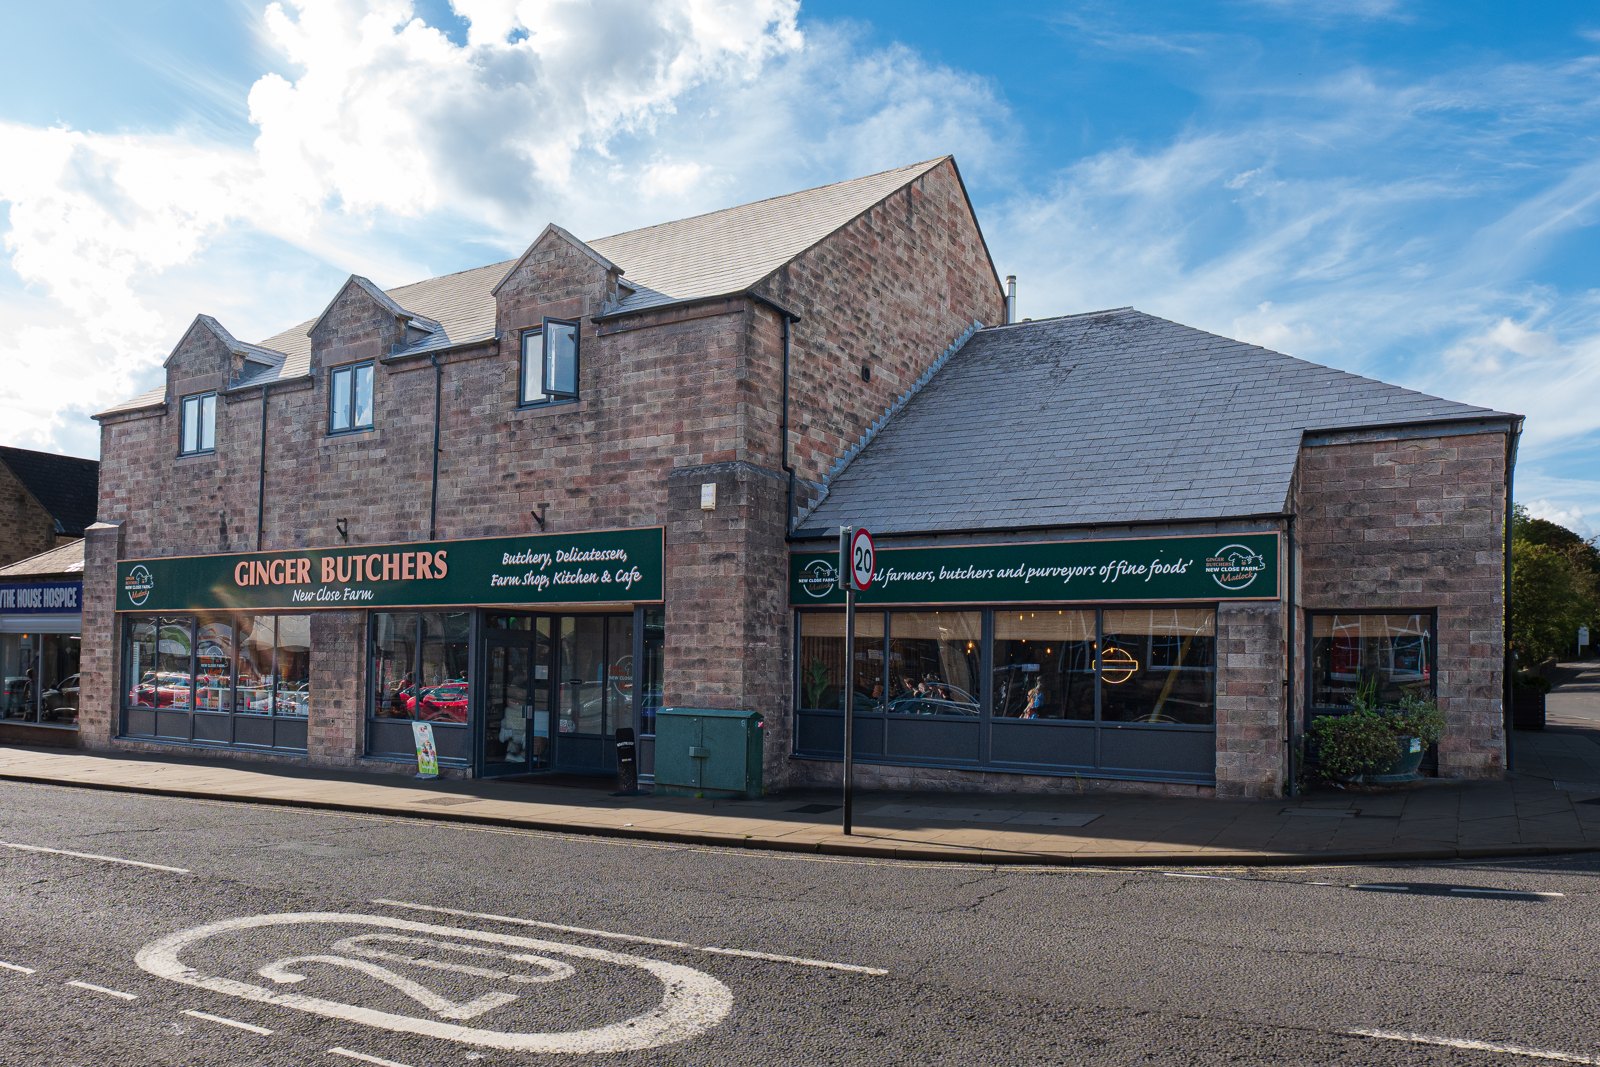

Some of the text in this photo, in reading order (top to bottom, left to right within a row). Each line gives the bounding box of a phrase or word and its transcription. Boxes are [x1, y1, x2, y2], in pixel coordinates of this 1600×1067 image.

[234, 550, 448, 587] GINGER BUTCHERS
[502, 546, 628, 571] Butchery, Delicatessen,
[856, 546, 872, 574] 20
[490, 566, 643, 592] Farm Shop, Kitchen & Cafe
[882, 567, 936, 589] farmers,
[939, 564, 995, 580] butchers
[997, 563, 1026, 578] and
[1024, 564, 1097, 584] purveyors
[1099, 560, 1117, 584] of
[1111, 559, 1147, 583] fine
[17, 588, 42, 608] HOUSE
[43, 587, 77, 608] HOSPICE
[292, 586, 374, 602] New Close Farm
[257, 932, 576, 1020] 20
